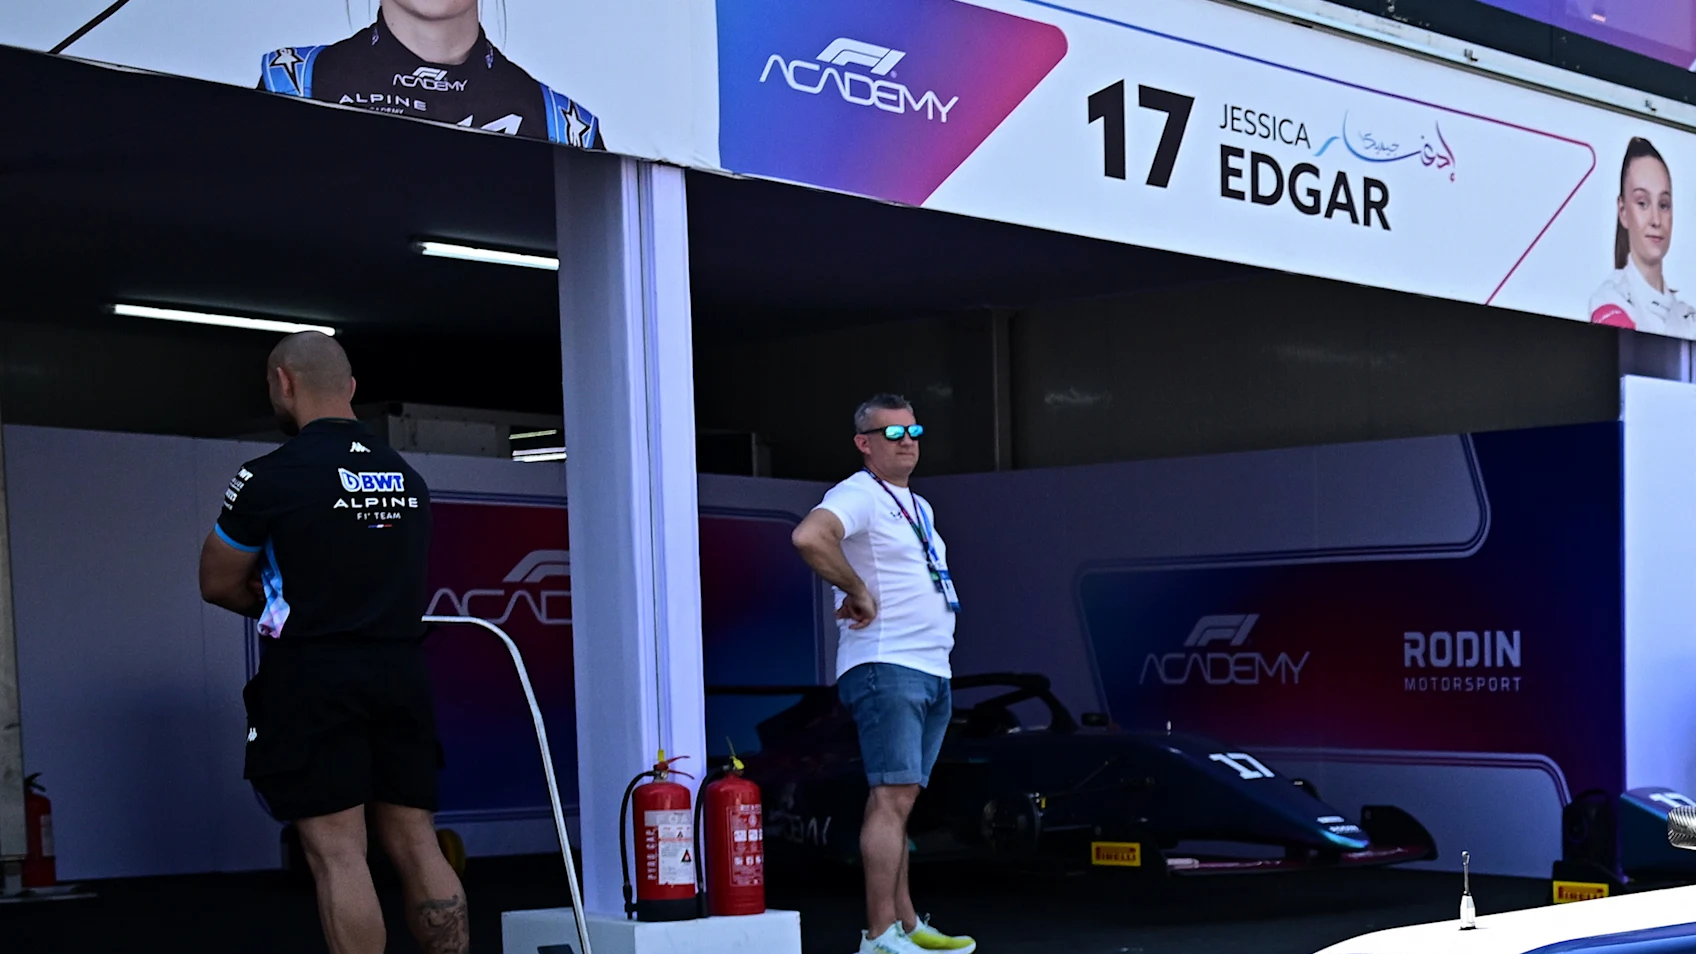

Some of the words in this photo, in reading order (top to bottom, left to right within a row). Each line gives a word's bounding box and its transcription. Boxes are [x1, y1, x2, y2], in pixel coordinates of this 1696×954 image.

[392, 73, 468, 92] ACADEMY
[759, 54, 959, 123] ACADEMY
[339, 93, 427, 112] ALPINE
[1087, 79, 1195, 188] 17
[1219, 103, 1311, 149] JESSICA
[1219, 143, 1392, 231] EDGAR
[360, 471, 405, 492] BWT
[333, 496, 419, 509] ALPINE
[374, 511, 402, 521] TEAM
[1403, 630, 1522, 668] RODIN
[1139, 651, 1310, 685] ACADEMY
[1403, 676, 1522, 692] MOTORSPORT
